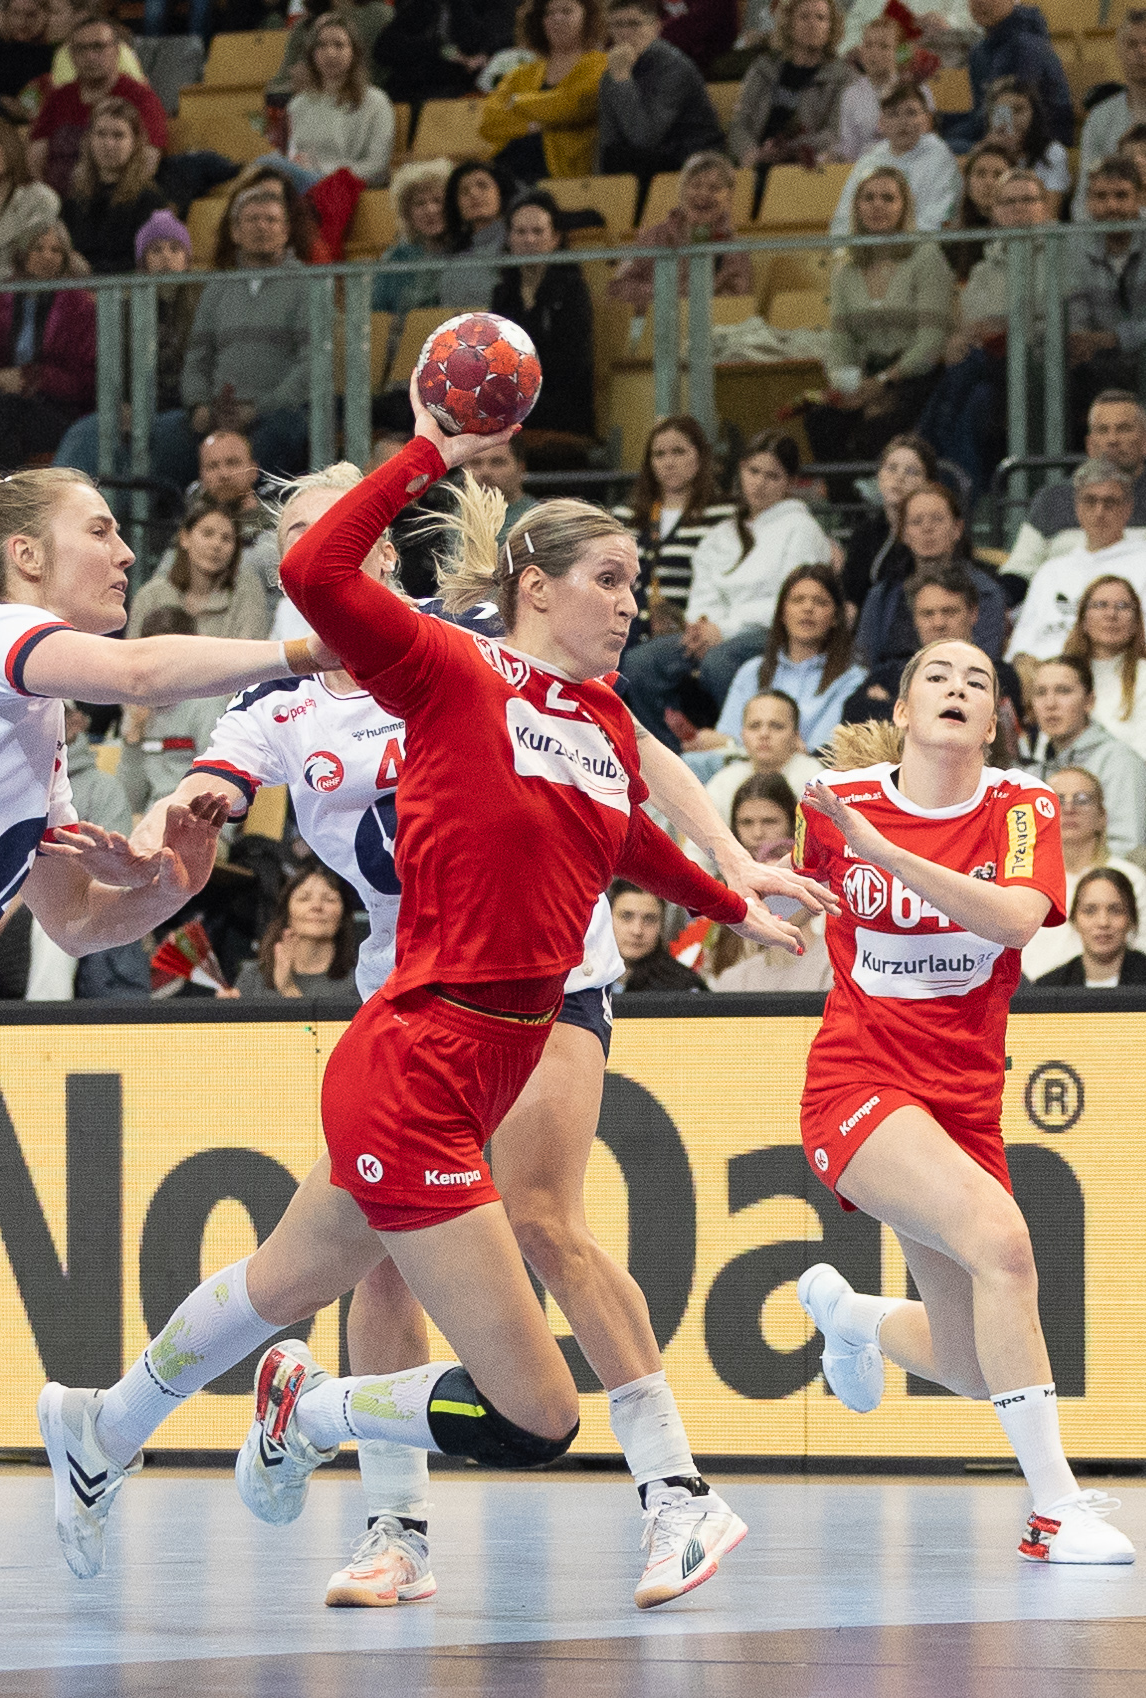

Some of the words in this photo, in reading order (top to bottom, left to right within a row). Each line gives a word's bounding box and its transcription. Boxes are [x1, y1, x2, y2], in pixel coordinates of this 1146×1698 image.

[366, 721, 405, 738] humme
[844, 866, 885, 917] MG
[839, 1095, 881, 1137] Kempa
[424, 1169, 482, 1187] Kempa
